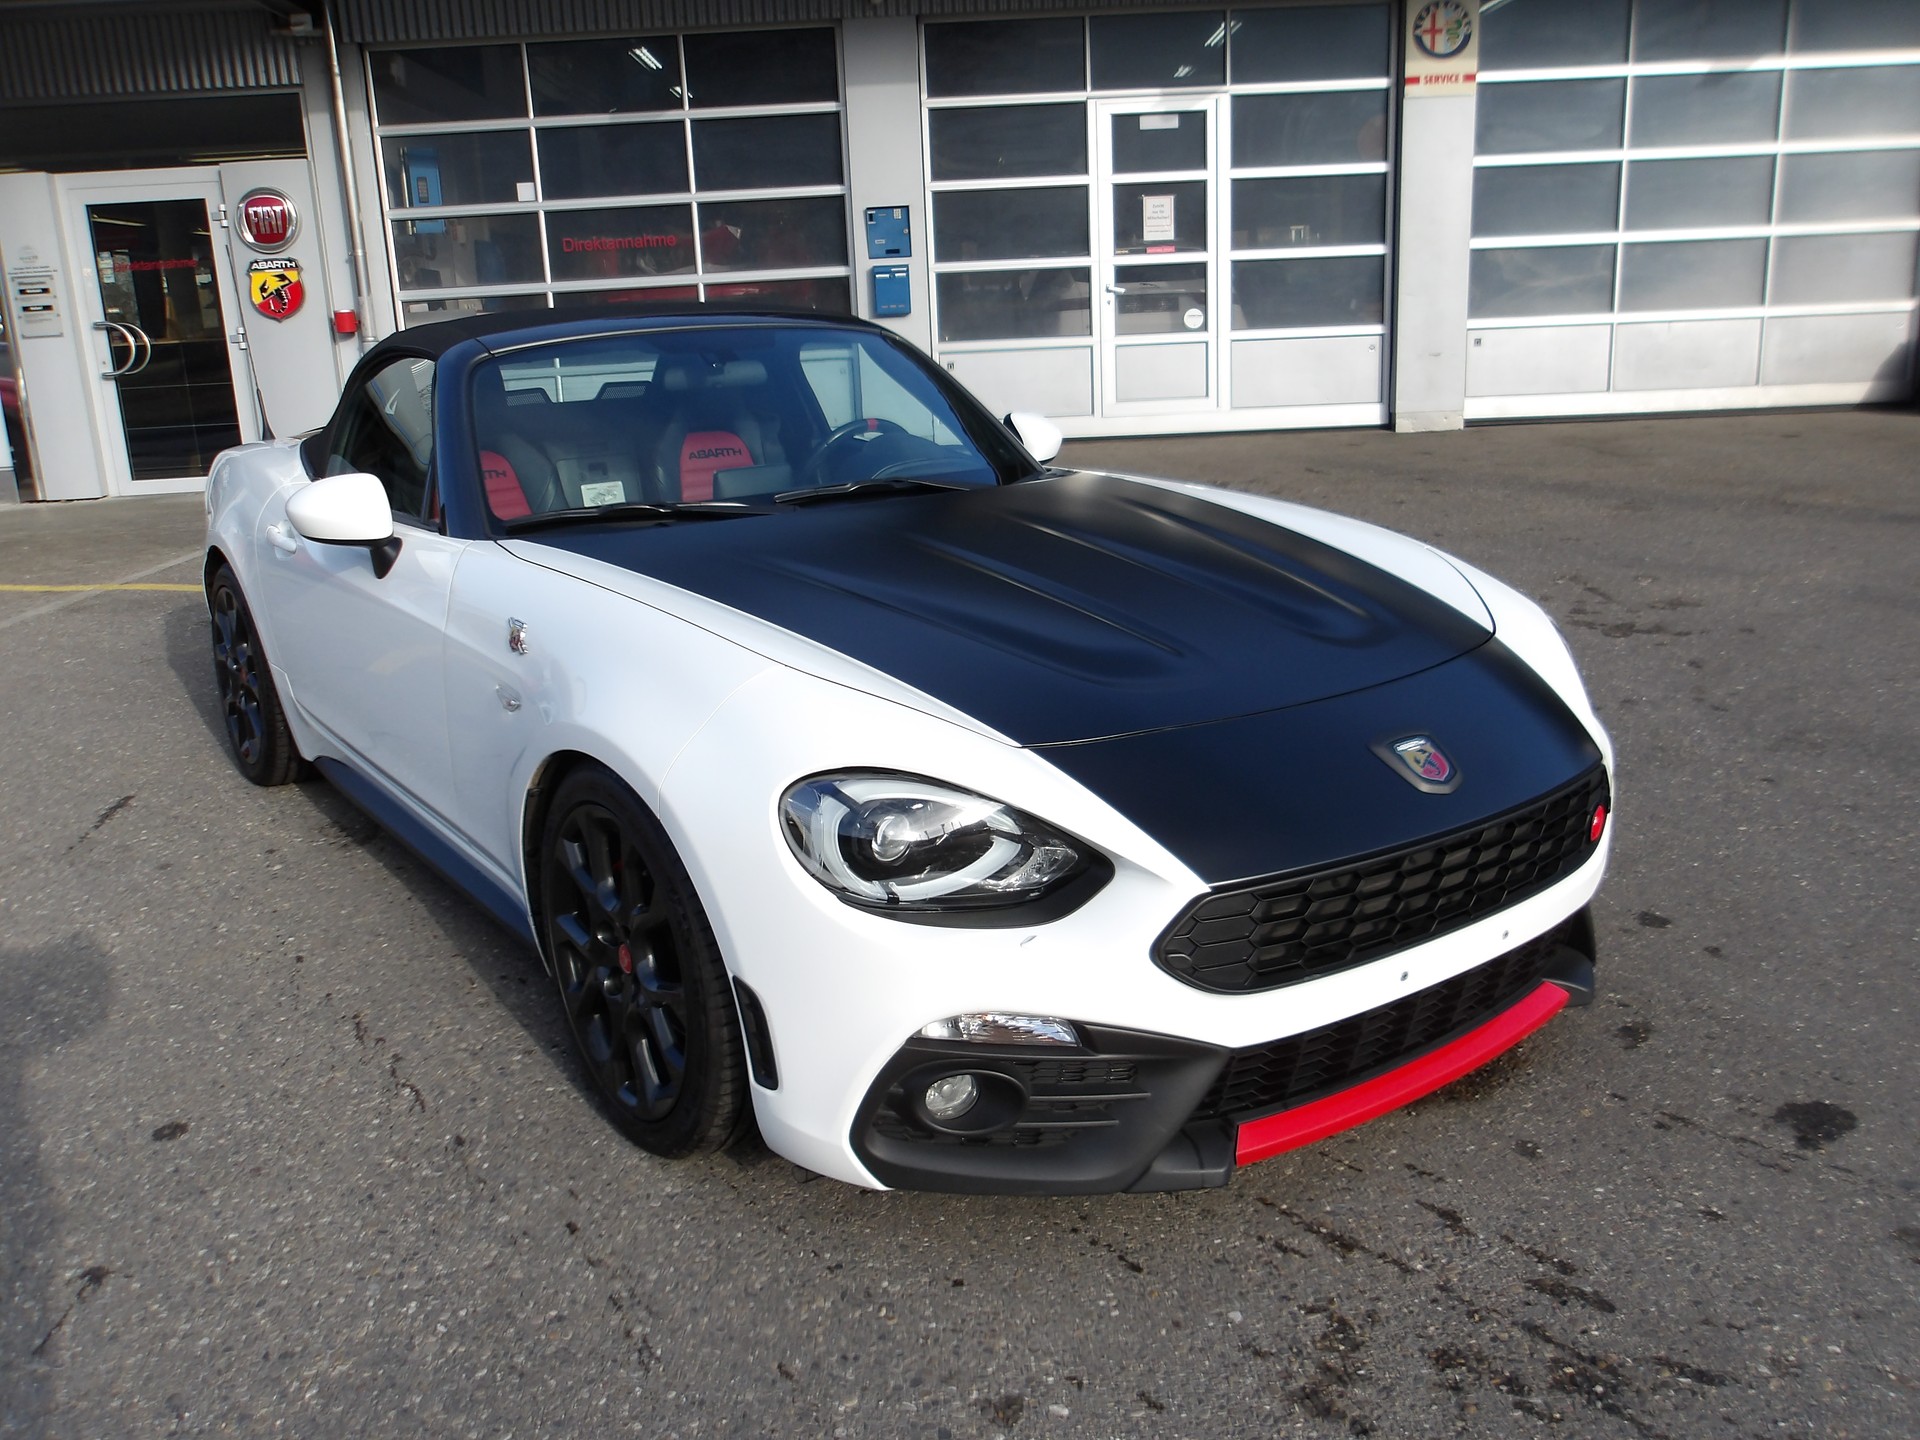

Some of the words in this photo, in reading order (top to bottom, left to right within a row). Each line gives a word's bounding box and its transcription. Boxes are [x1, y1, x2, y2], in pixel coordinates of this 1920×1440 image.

[1423, 74, 1460, 85] SERVICE
[248, 205, 284, 235] FIAT
[562, 234, 677, 253] Direktannahme
[251, 260, 296, 270] ABARTH
[688, 448, 742, 460] ABARTH
